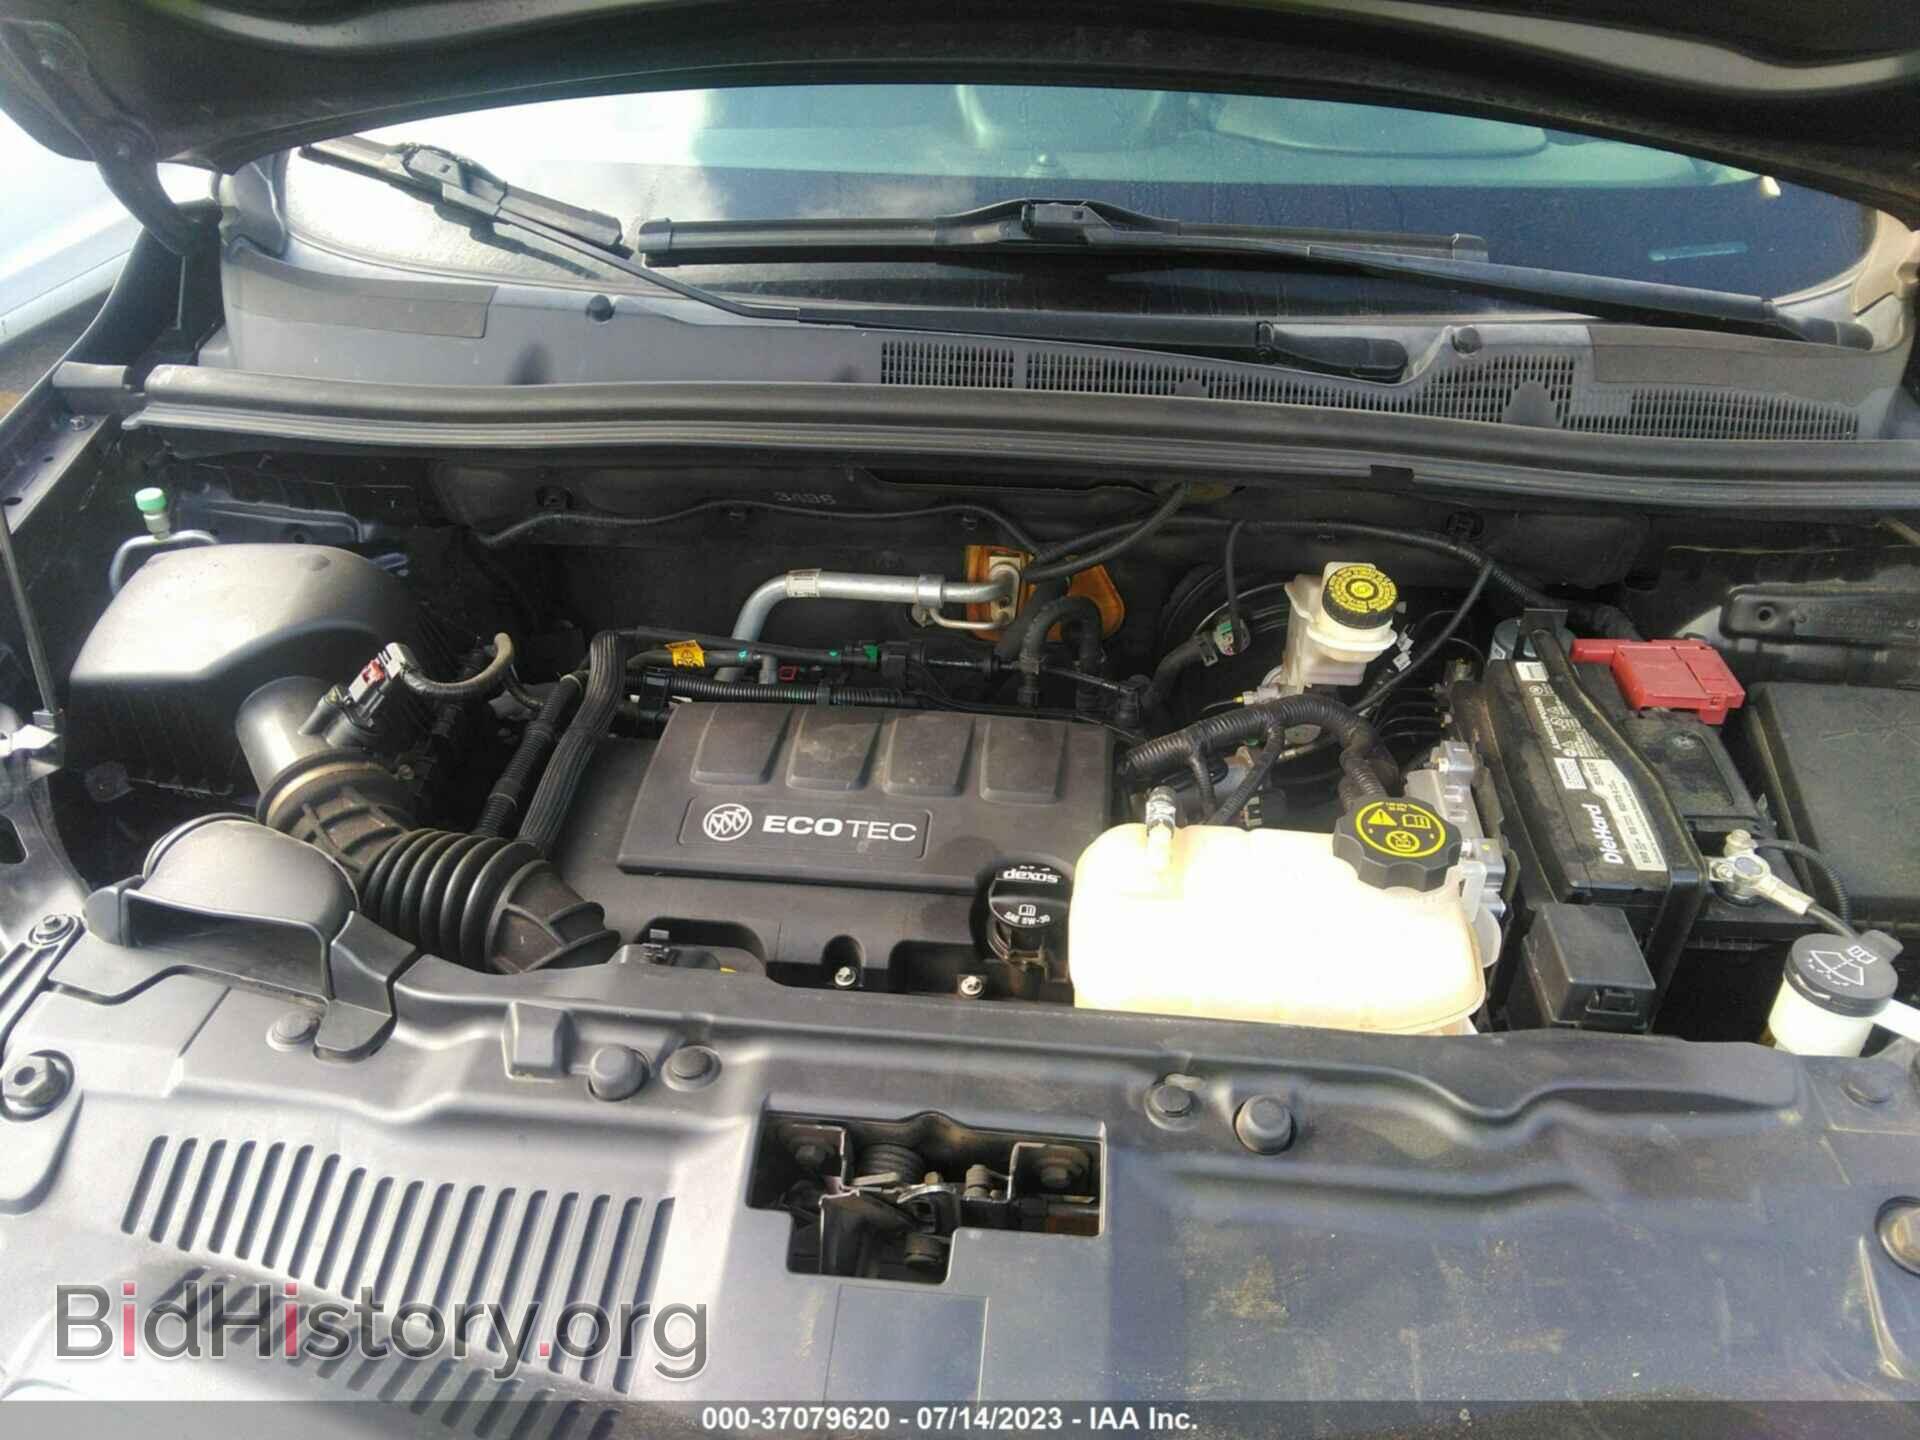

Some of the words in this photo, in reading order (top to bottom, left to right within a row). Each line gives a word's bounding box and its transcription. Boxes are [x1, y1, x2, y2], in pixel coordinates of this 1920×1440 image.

[762, 815, 918, 842] ECOTEC
[1582, 803, 1625, 865] DieHard
[1003, 869, 1058, 884] dexos
